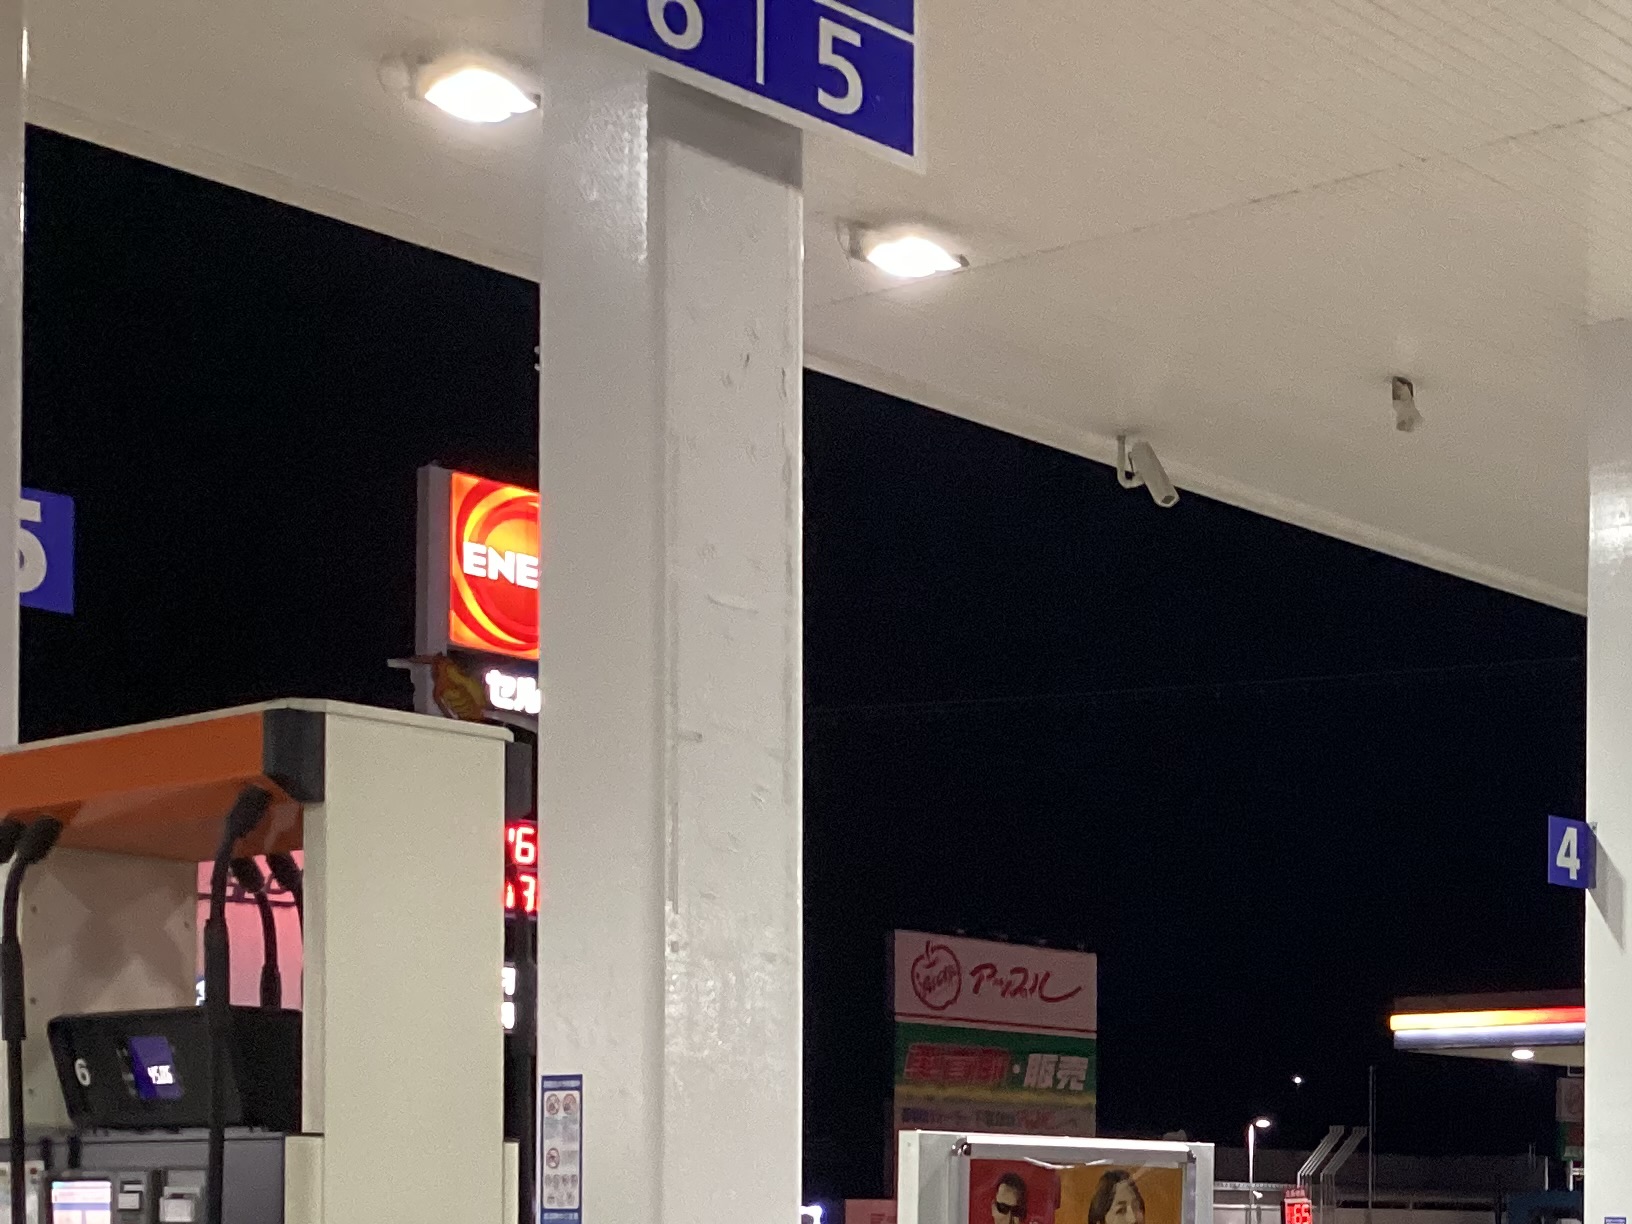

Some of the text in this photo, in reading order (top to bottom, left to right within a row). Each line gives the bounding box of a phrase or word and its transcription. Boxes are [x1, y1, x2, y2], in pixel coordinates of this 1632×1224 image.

[818, 16, 863, 115] 5
[462, 540, 540, 589] ENE
[1556, 826, 1580, 880] 4
[74, 1058, 91, 1087] 6
